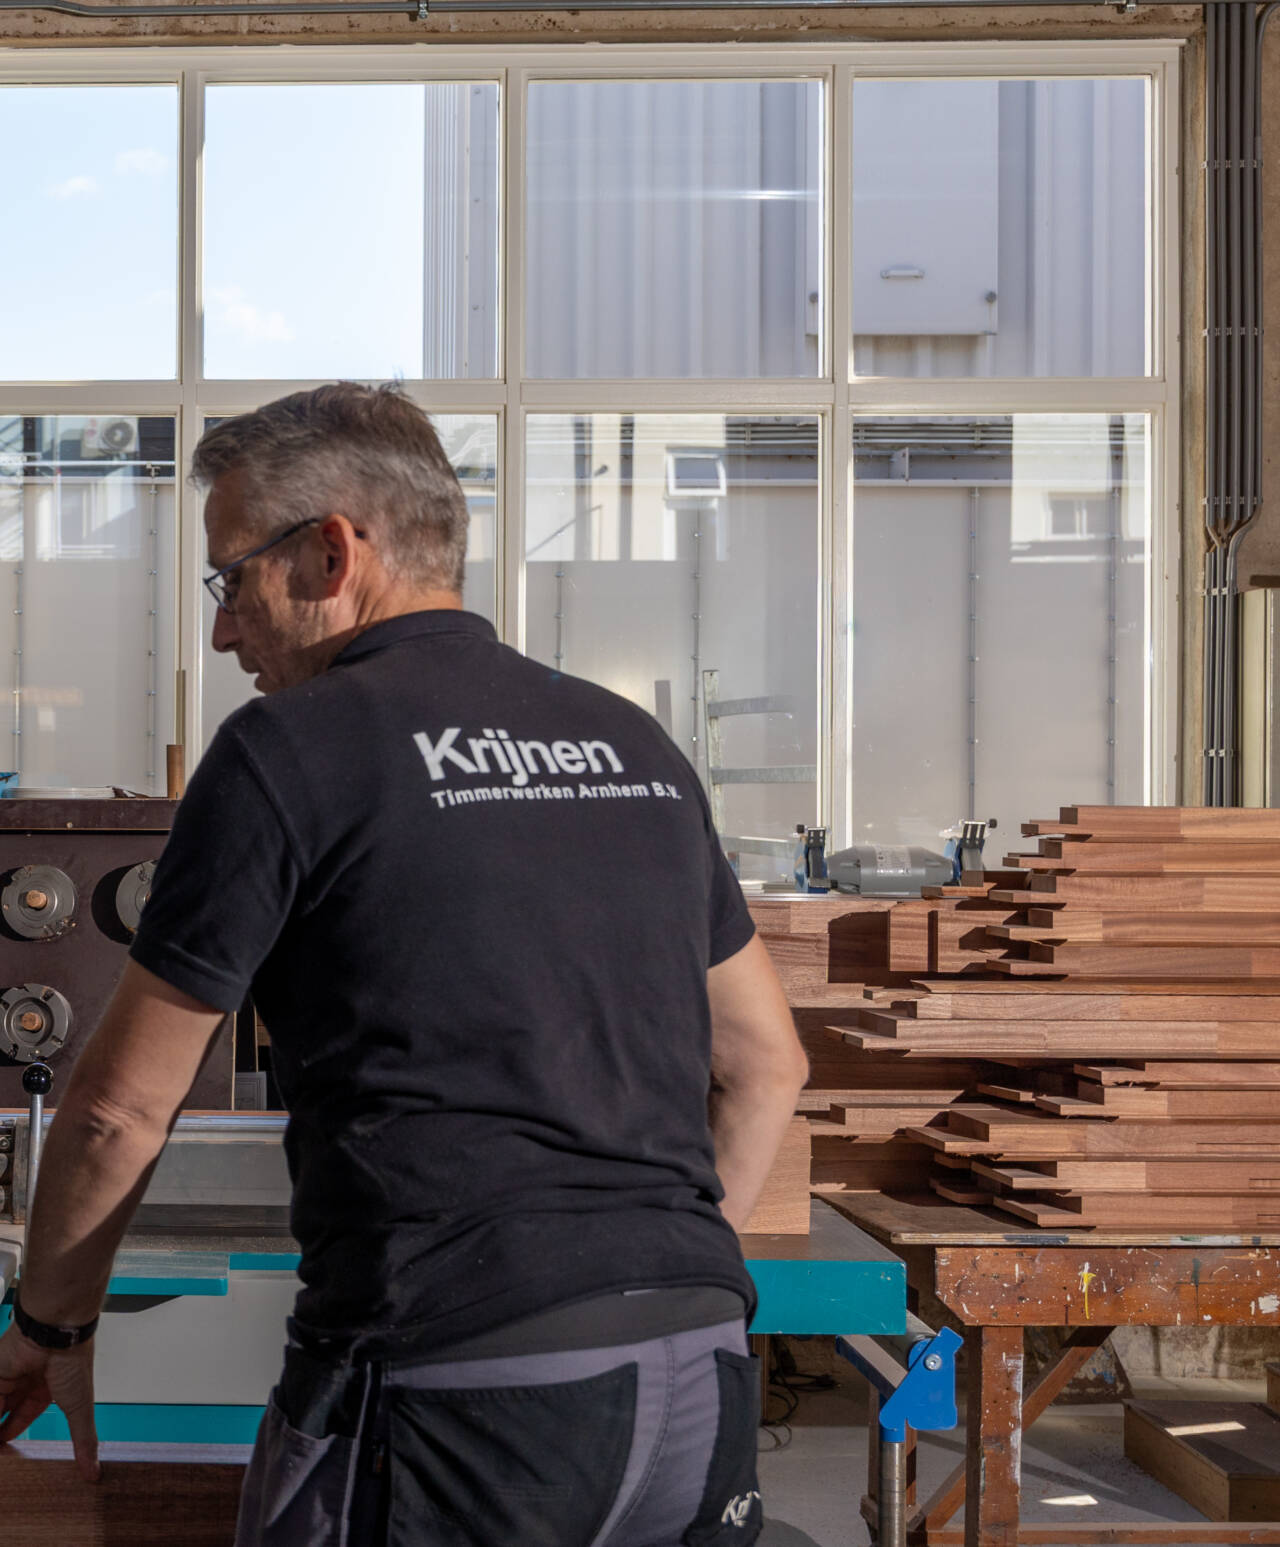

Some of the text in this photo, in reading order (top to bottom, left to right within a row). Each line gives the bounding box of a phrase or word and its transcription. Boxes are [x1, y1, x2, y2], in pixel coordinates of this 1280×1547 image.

[412, 727, 624, 787] Krijnen
[430, 783, 575, 809] Timmerwerken
[578, 782, 650, 800] Arnhem
